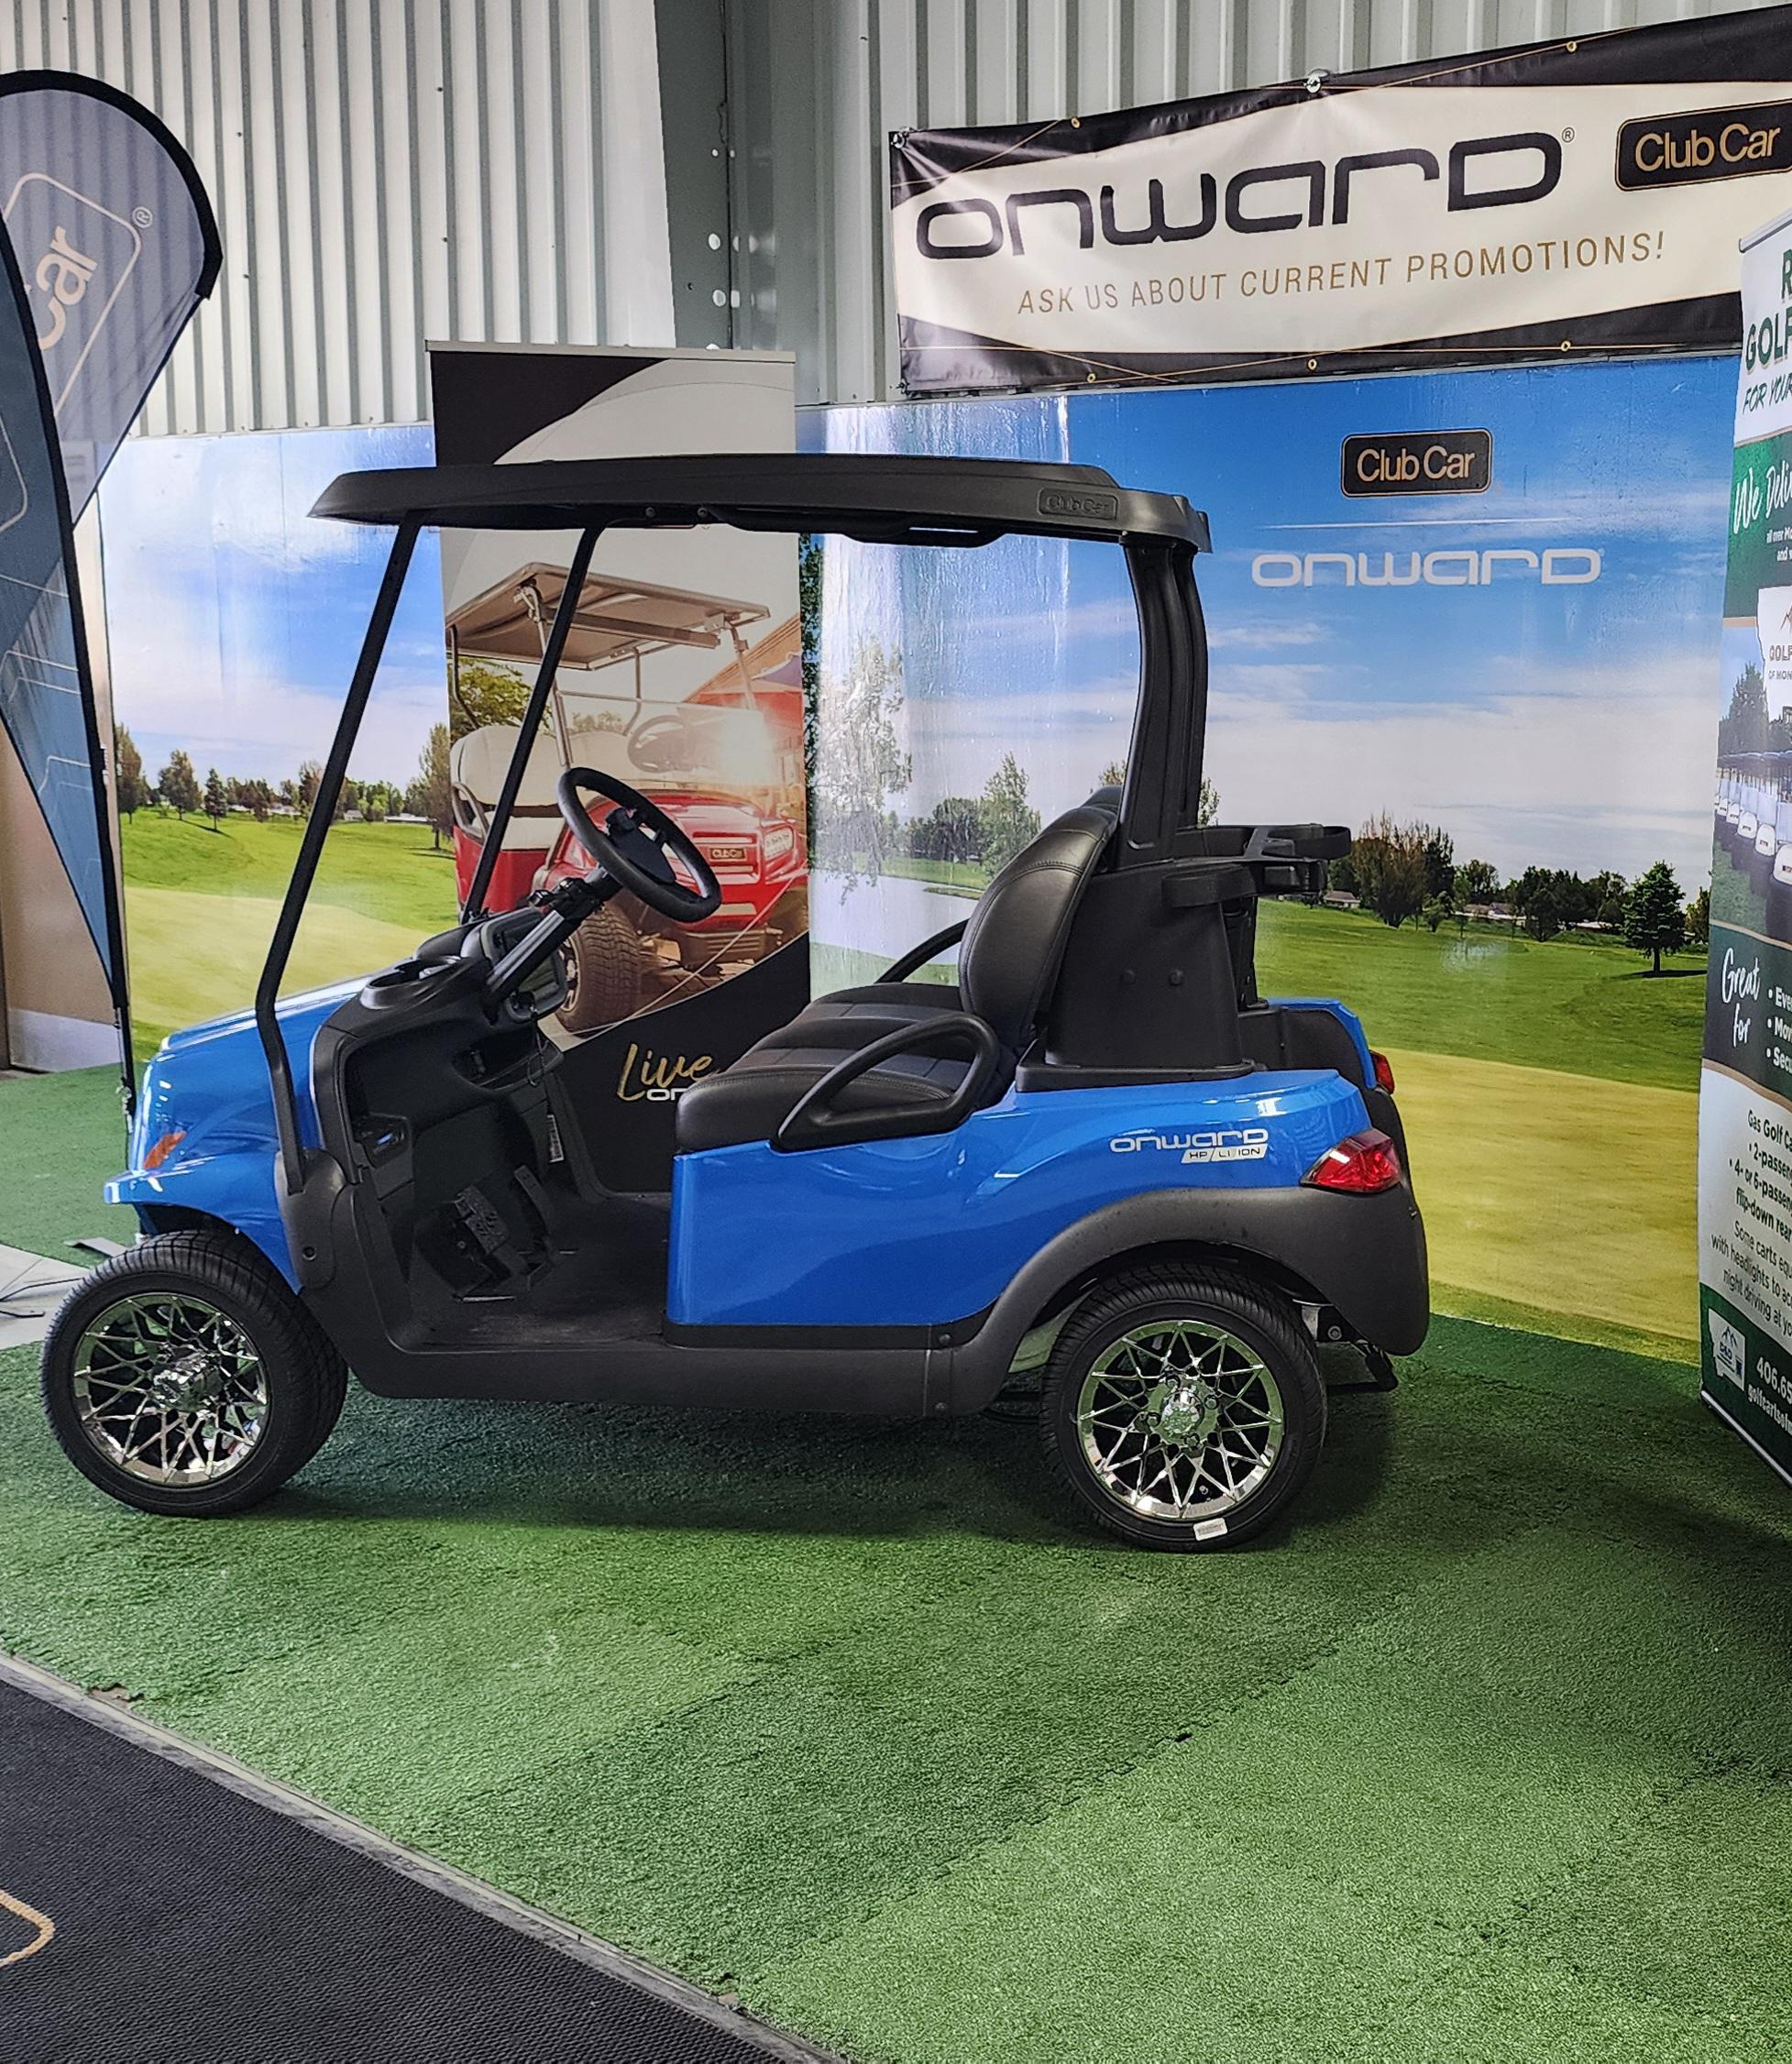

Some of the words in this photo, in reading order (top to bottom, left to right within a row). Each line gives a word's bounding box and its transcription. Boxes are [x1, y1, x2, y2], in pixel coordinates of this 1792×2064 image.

[1634, 129, 1715, 172] Club
[1720, 123, 1781, 162] Car
[1017, 286, 1074, 315] ASK
[1085, 282, 1118, 311] US
[1131, 273, 1227, 308] ABOUT
[1240, 258, 1391, 297] CURRENT
[1406, 231, 1665, 283] PROMOTIONS!
[1357, 448, 1418, 482] Club
[1423, 445, 1475, 480] Car
[1733, 467, 1763, 534] We
[1721, 948, 1760, 1003] Great
[617, 1044, 717, 1101] Live
[1238, 1147, 1260, 1157] ION
[1764, 1119, 1783, 1145] Golf
[1756, 1242, 1776, 1266] carts
[1772, 1276, 1781, 1297] to
